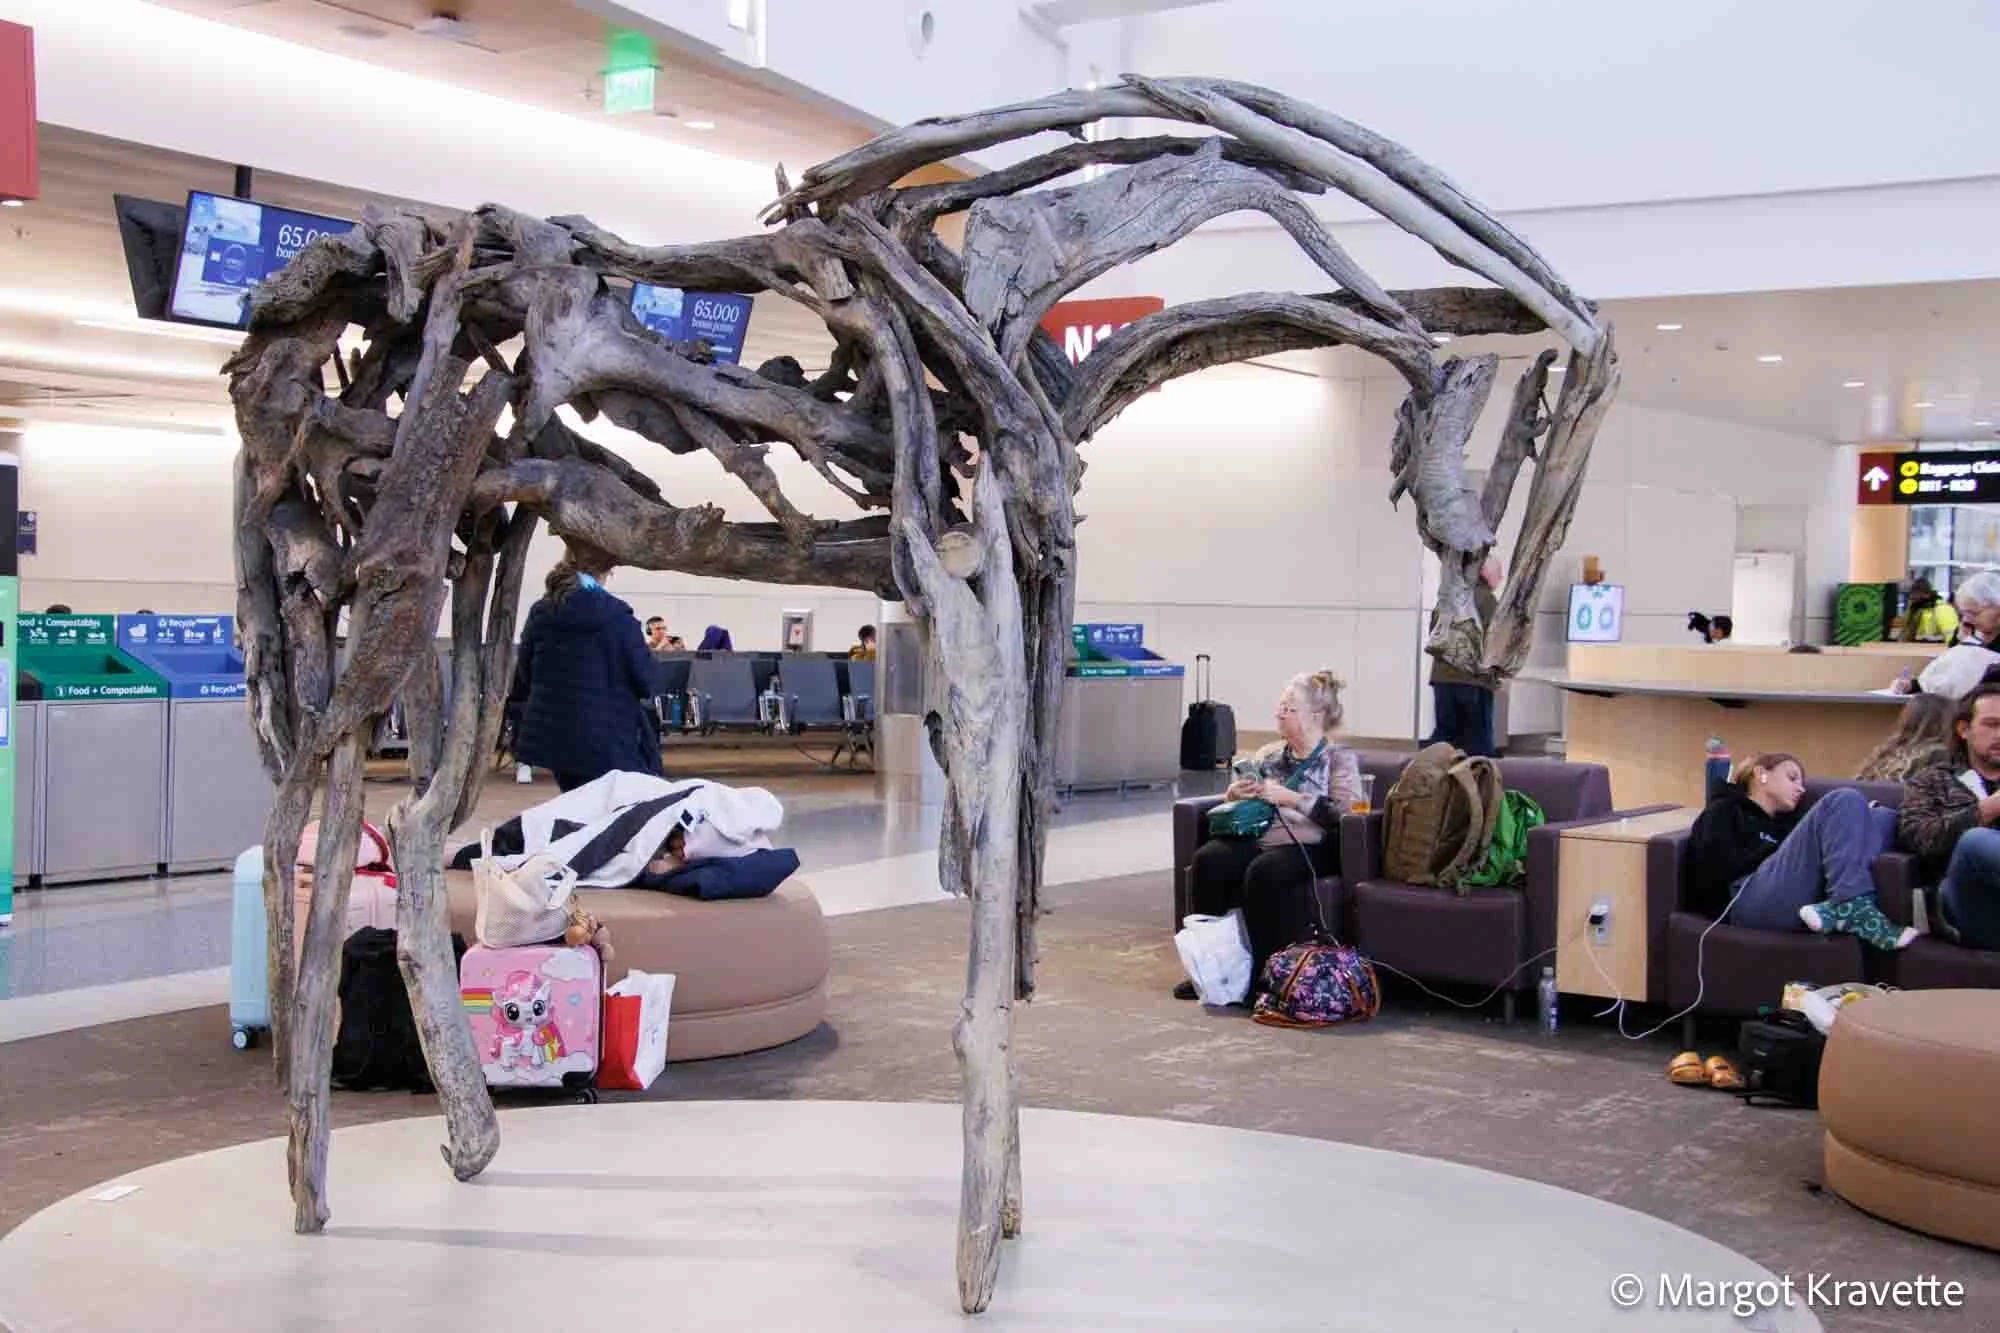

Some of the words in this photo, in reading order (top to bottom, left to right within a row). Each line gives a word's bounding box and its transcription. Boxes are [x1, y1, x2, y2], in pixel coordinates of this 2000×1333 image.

[68, 686, 90, 695] Food
[100, 684, 157, 696] Compostables
[211, 685, 237, 695] Recycle
